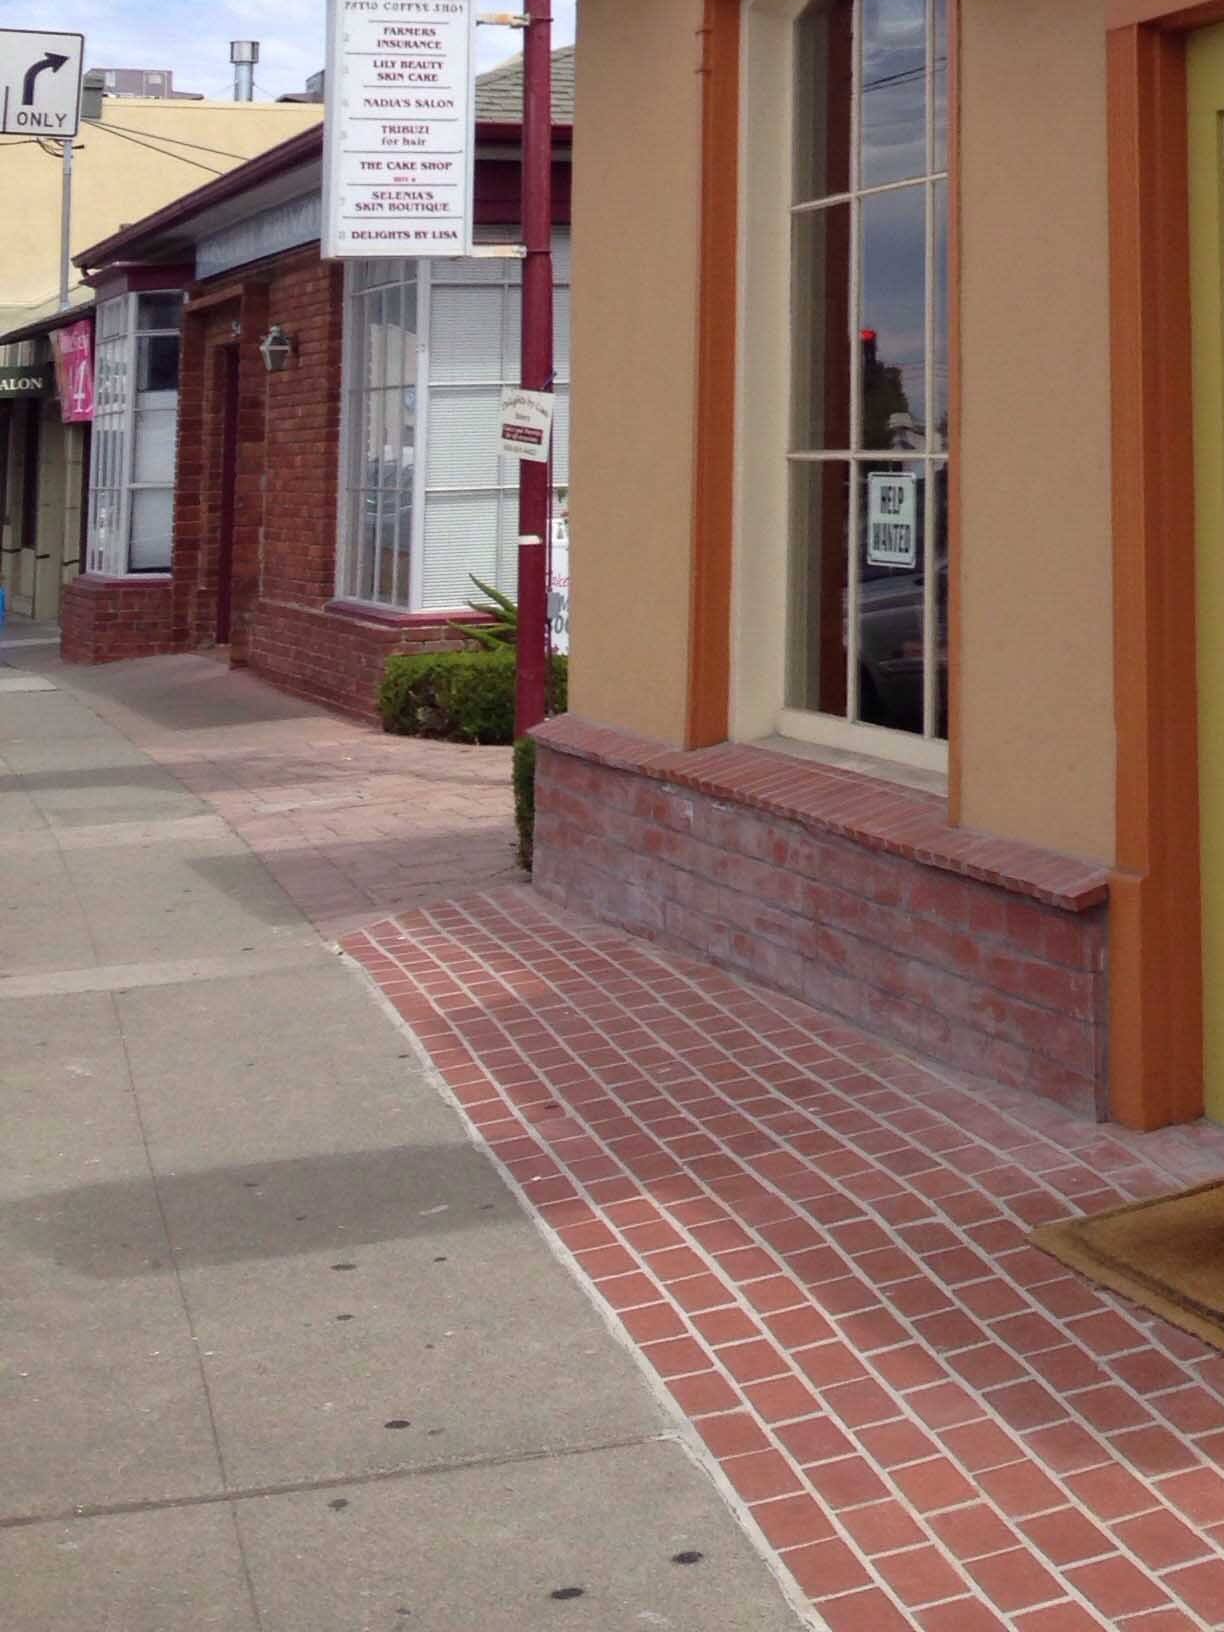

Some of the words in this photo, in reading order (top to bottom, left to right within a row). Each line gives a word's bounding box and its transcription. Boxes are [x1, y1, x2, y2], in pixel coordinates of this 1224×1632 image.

[383, 27, 436, 36] FARMERS
[376, 39, 442, 49] INSURANCE
[373, 59, 396, 69] LILY
[400, 60, 443, 70] BEAUTY
[377, 72, 404, 81] SKIN
[408, 73, 439, 82] CARE
[415, 99, 454, 108] SALON
[16, 111, 67, 128] ONLY
[382, 137, 399, 145] for
[402, 137, 426, 146] hair
[360, 161, 382, 170] THE
[386, 161, 416, 170] CAKE
[420, 161, 453, 171] SHOP
[355, 202, 384, 212] SKIN
[388, 202, 449, 212] BOUTIQUE
[351, 230, 411, 240] DELIGHTS
[414, 231, 429, 240] BY
[432, 231, 459, 240] LISA
